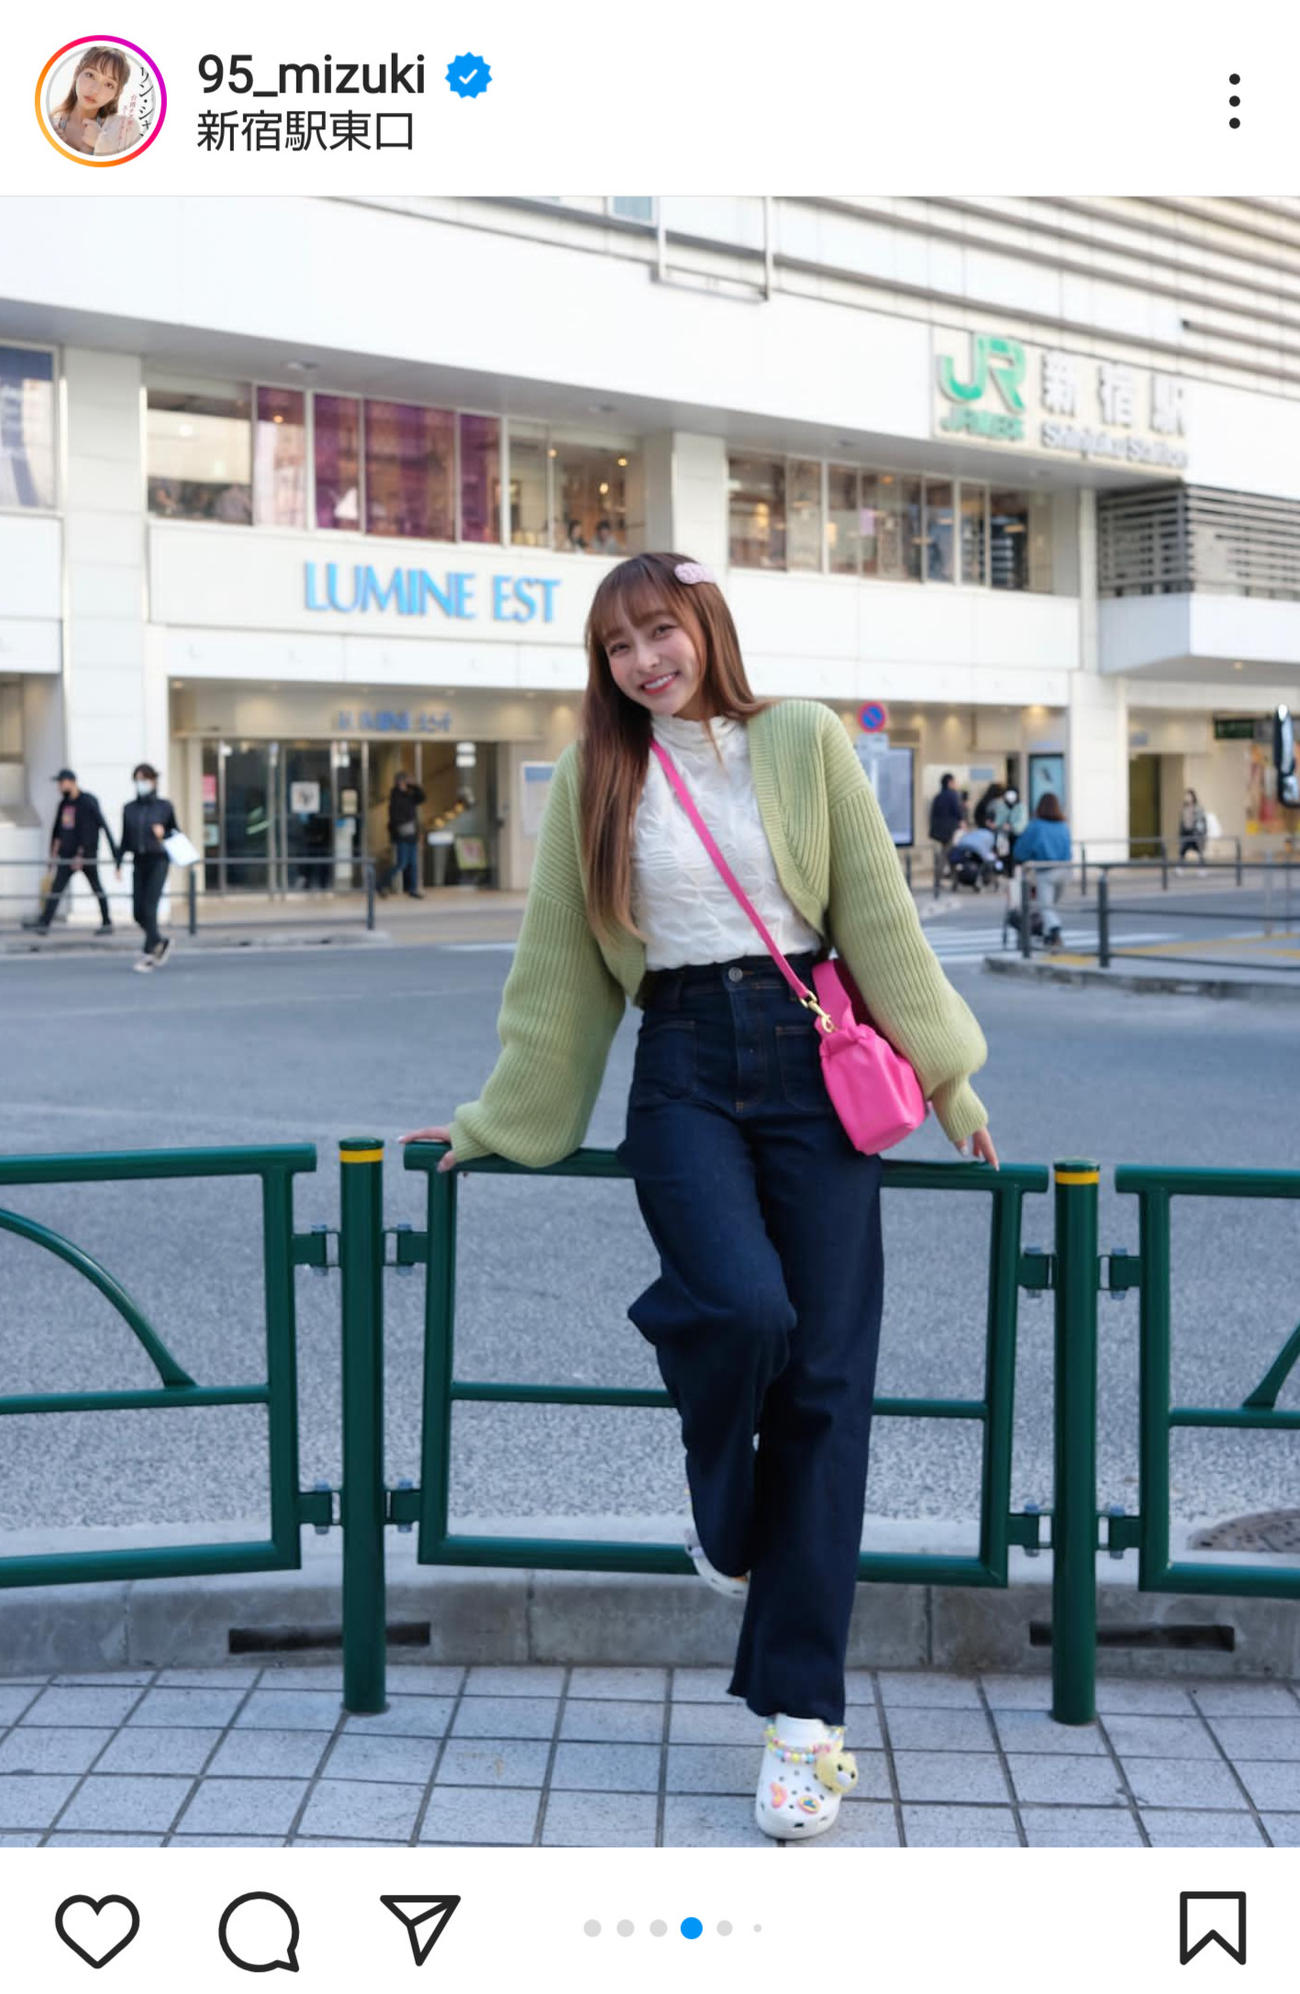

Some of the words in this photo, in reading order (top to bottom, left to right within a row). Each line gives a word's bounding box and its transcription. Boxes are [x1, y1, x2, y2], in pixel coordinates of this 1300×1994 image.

[936, 332, 1027, 413] JR
[303, 561, 476, 619] LUMINE
[491, 575, 560, 623] EST
